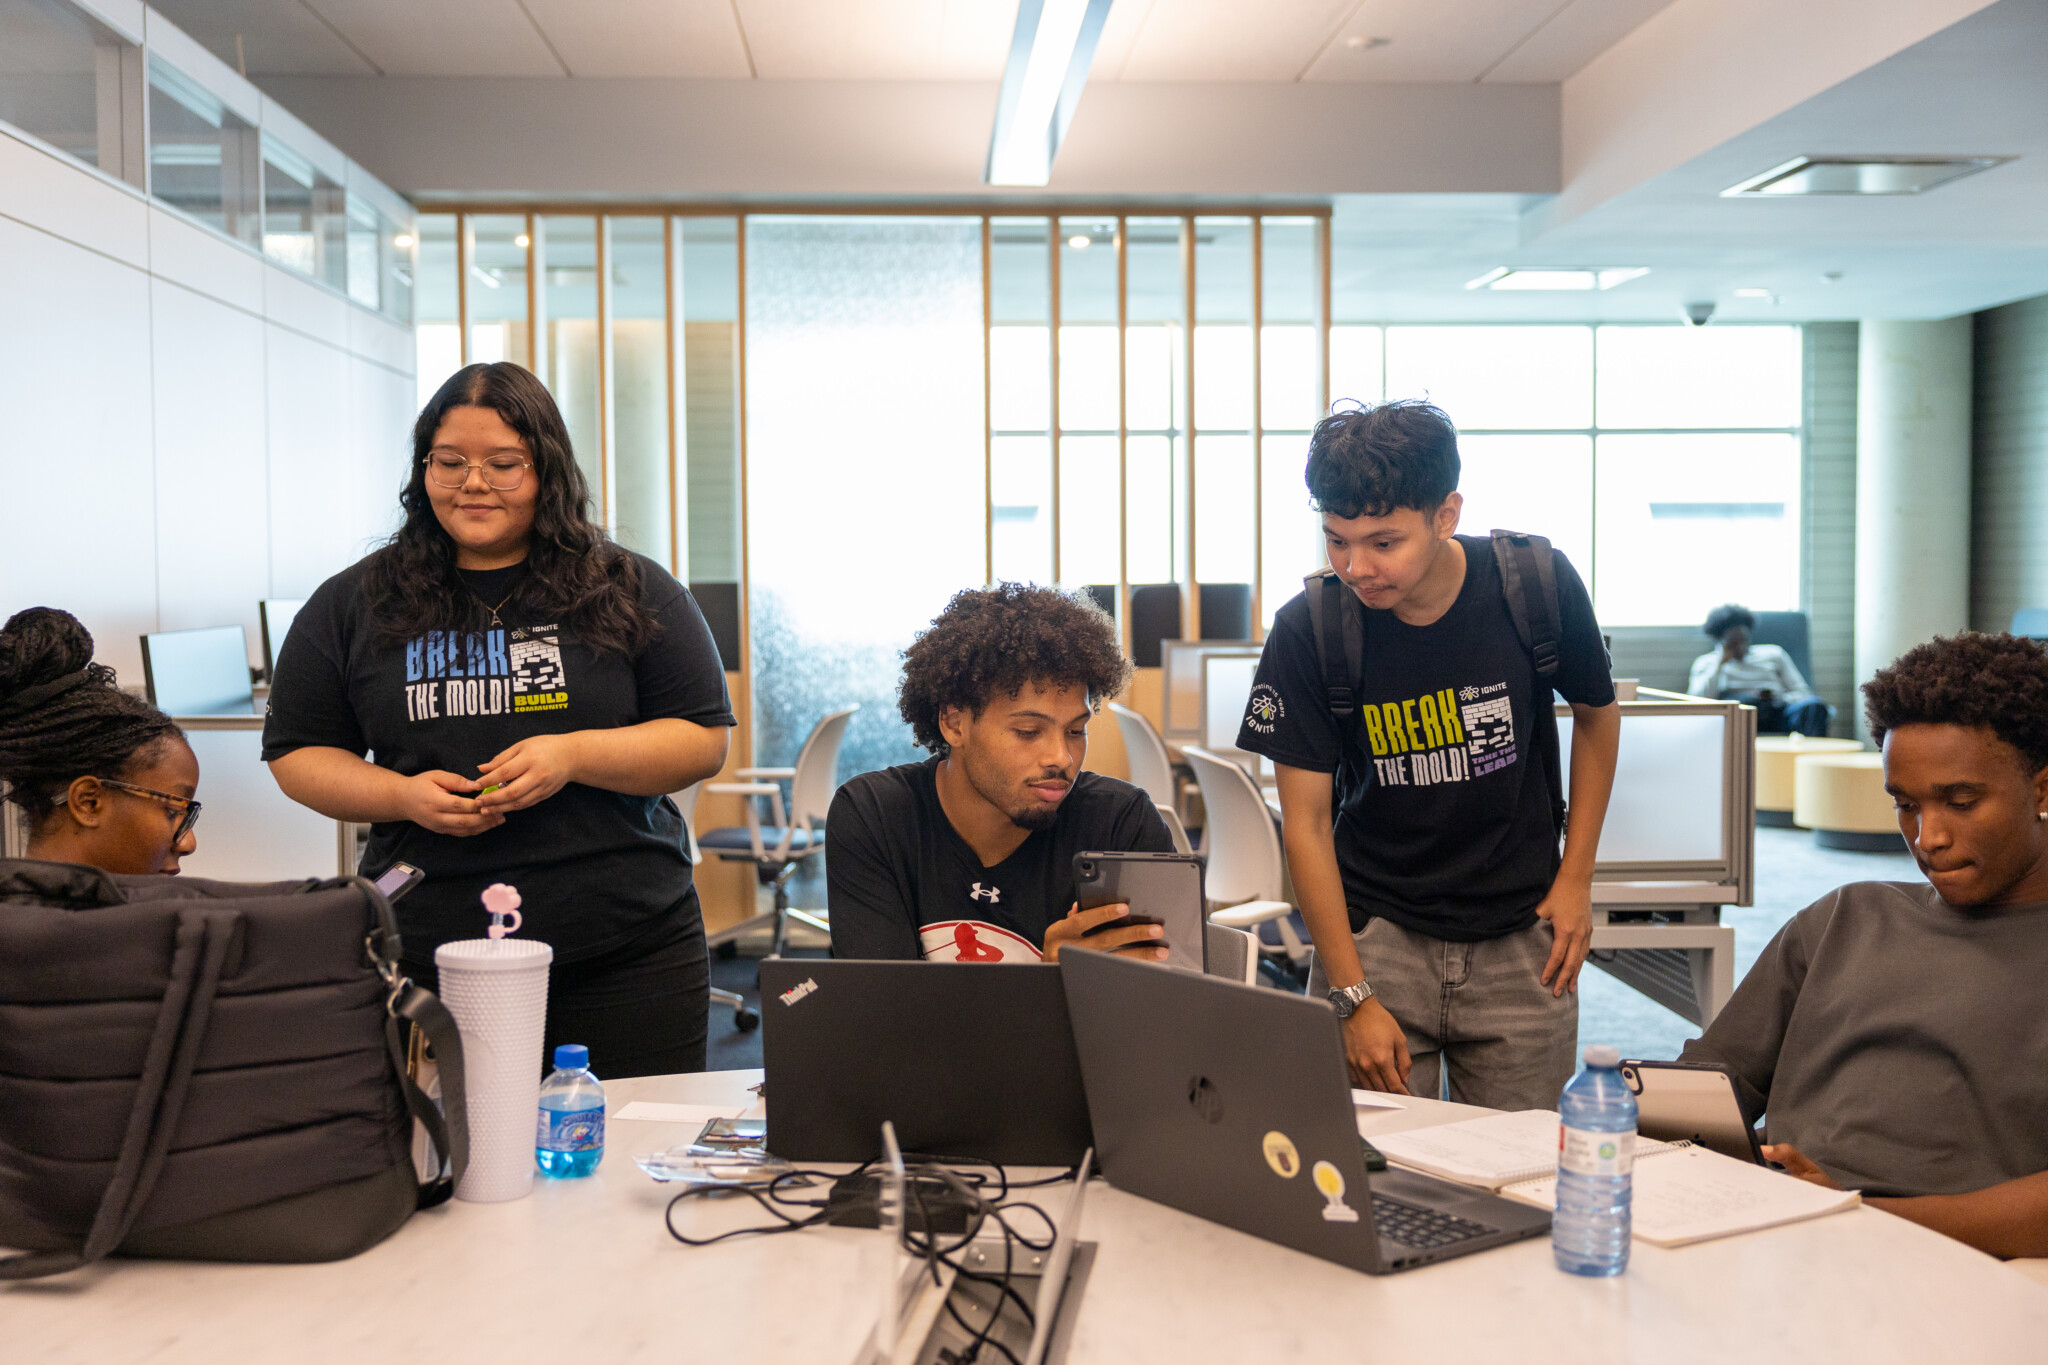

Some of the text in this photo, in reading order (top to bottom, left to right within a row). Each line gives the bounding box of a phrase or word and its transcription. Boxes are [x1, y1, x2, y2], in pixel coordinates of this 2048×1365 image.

[532, 624, 558, 632] IGNITE
[406, 630, 508, 682] BREAK
[514, 692, 568, 706] BUILD
[1481, 682, 1506, 694] IGNITE
[405, 678, 511, 721] THE MOLD!
[514, 702, 568, 713] COMMUNITY
[1246, 715, 1274, 733] IGNITE
[1362, 688, 1464, 756] BREAK
[1472, 744, 1516, 764] TAKE THE
[1474, 752, 1517, 777] LEAD
[1373, 746, 1471, 787] THE MOLD!
[778, 977, 819, 1007] ThinkPad
